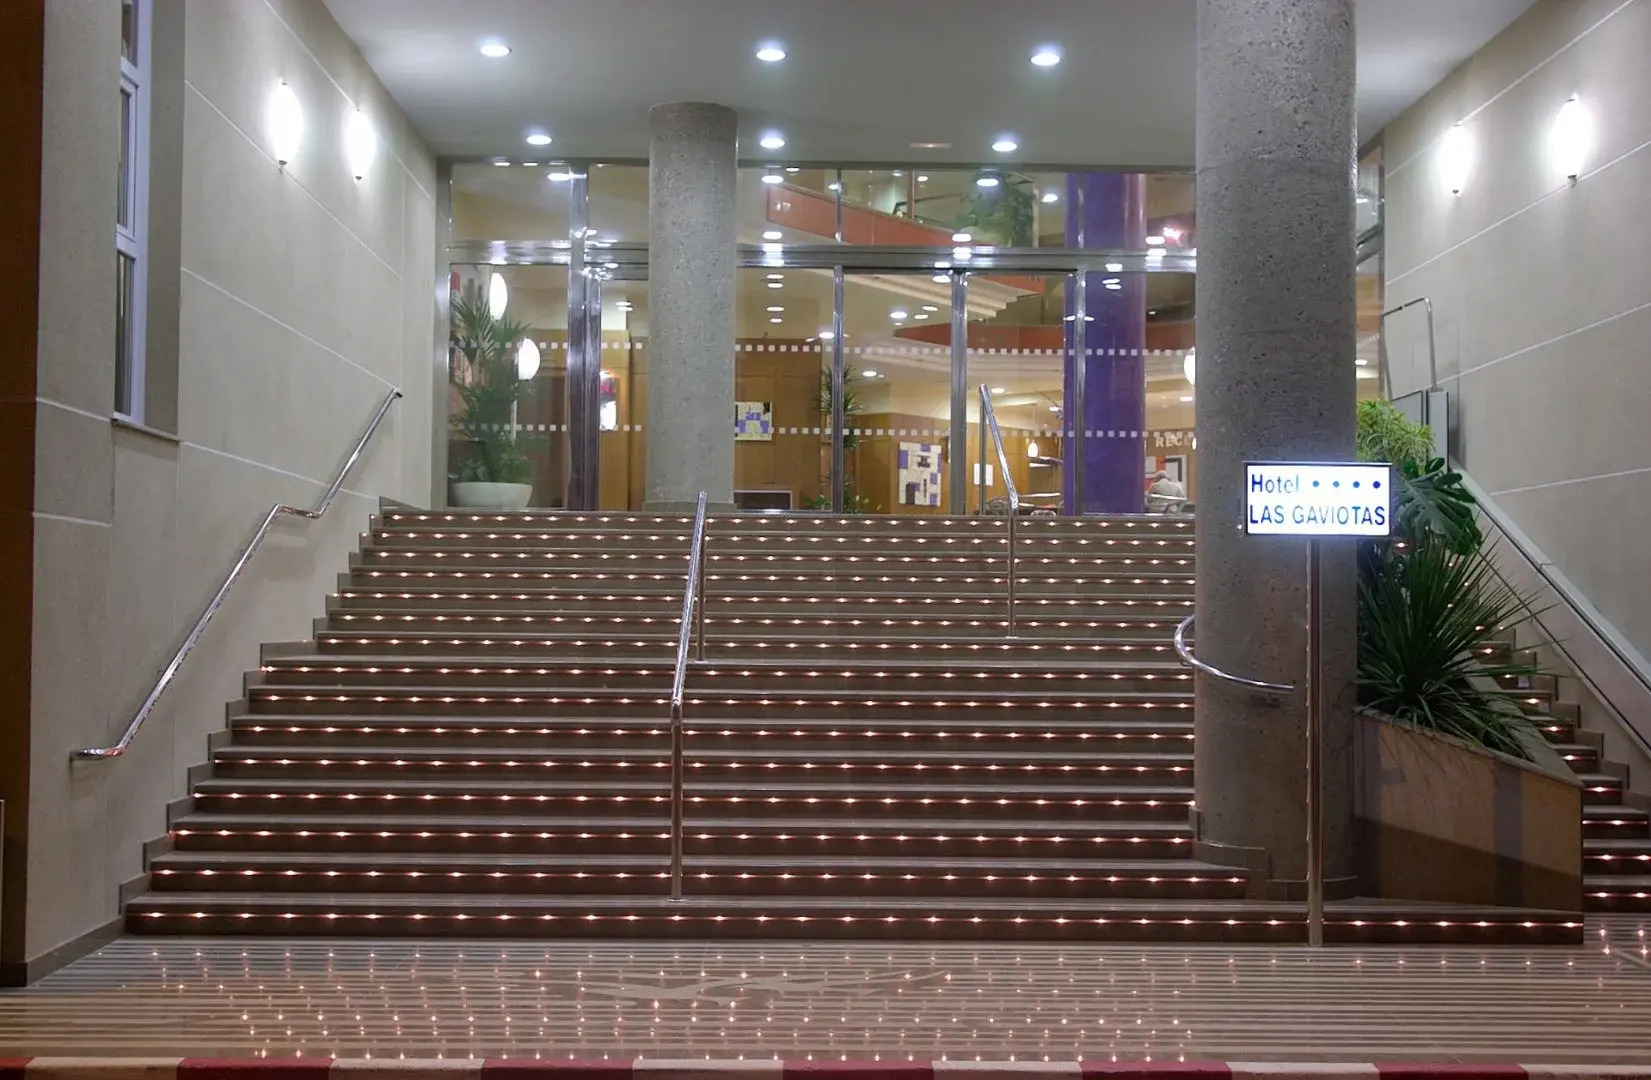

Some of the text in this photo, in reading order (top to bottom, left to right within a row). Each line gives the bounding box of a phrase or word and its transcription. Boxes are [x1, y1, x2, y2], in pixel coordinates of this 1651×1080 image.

[1251, 474, 1299, 493] Hotel
[1250, 504, 1386, 526] LAS GAVIOTAS
